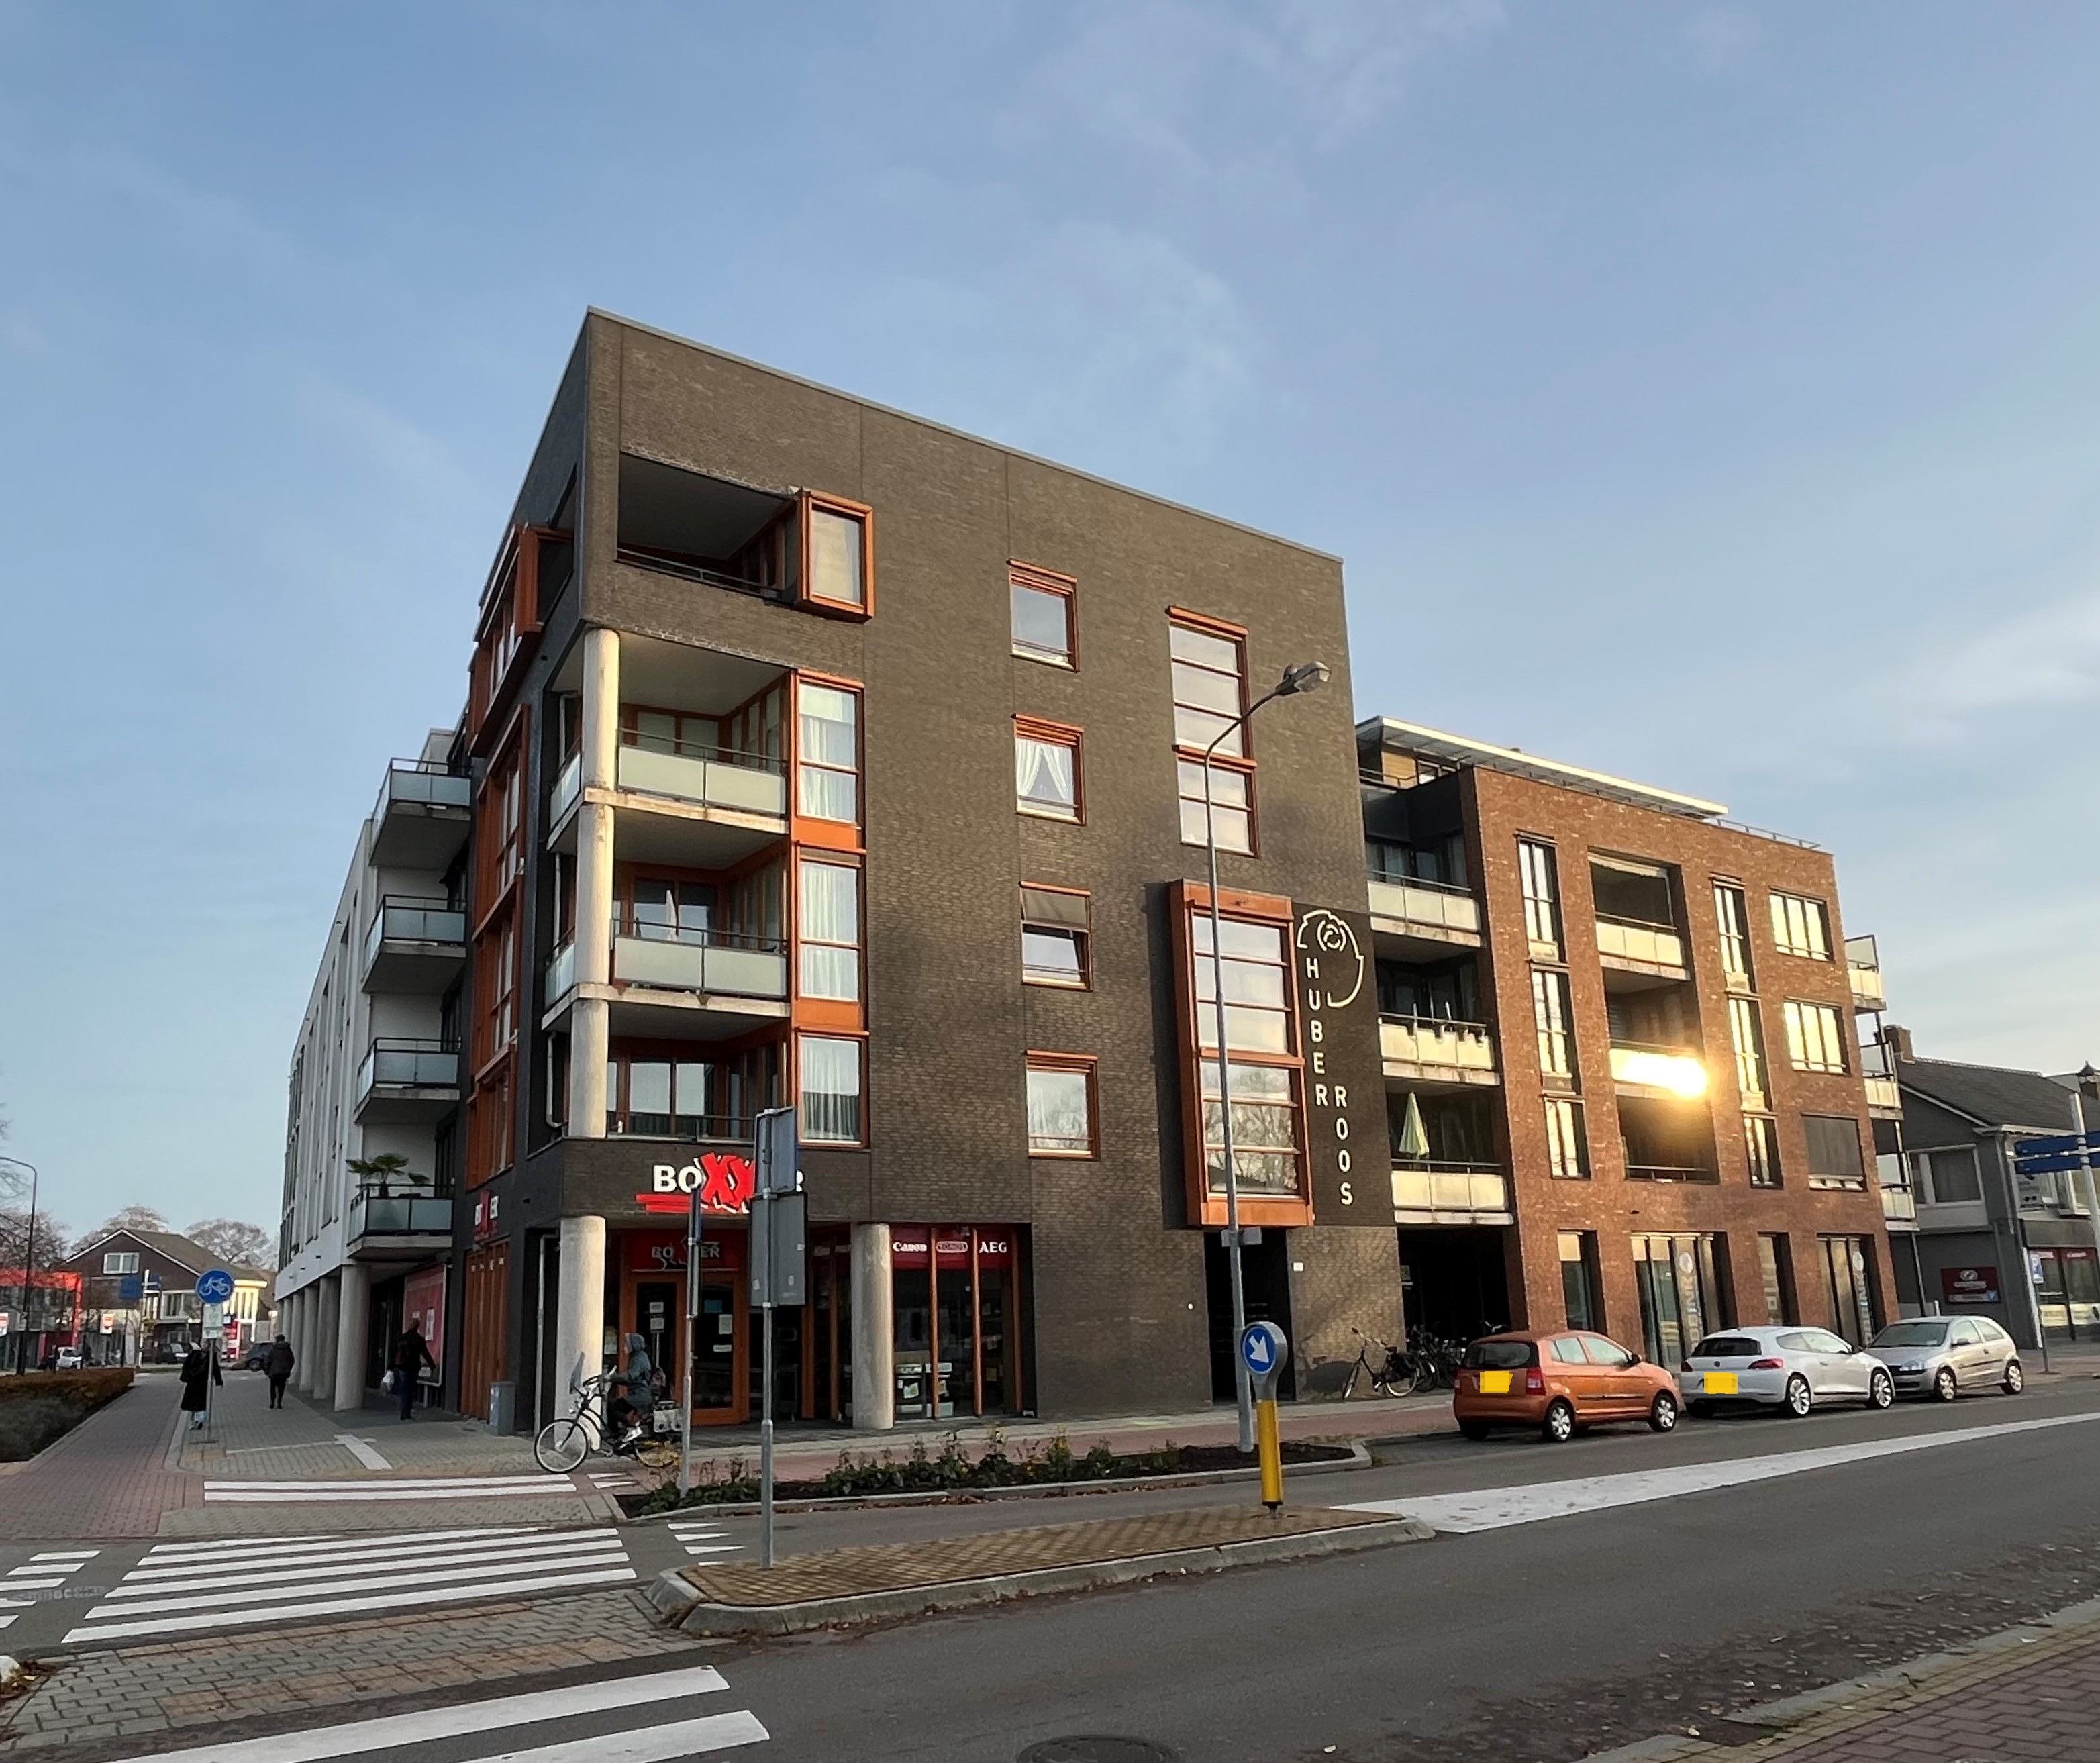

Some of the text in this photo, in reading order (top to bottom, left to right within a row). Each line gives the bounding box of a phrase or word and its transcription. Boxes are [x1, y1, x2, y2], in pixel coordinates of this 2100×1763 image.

[1306, 957, 1329, 1107] HUBER
[1334, 1085, 1354, 1205] ROOS
[979, 1241, 1007, 1254] AEG
